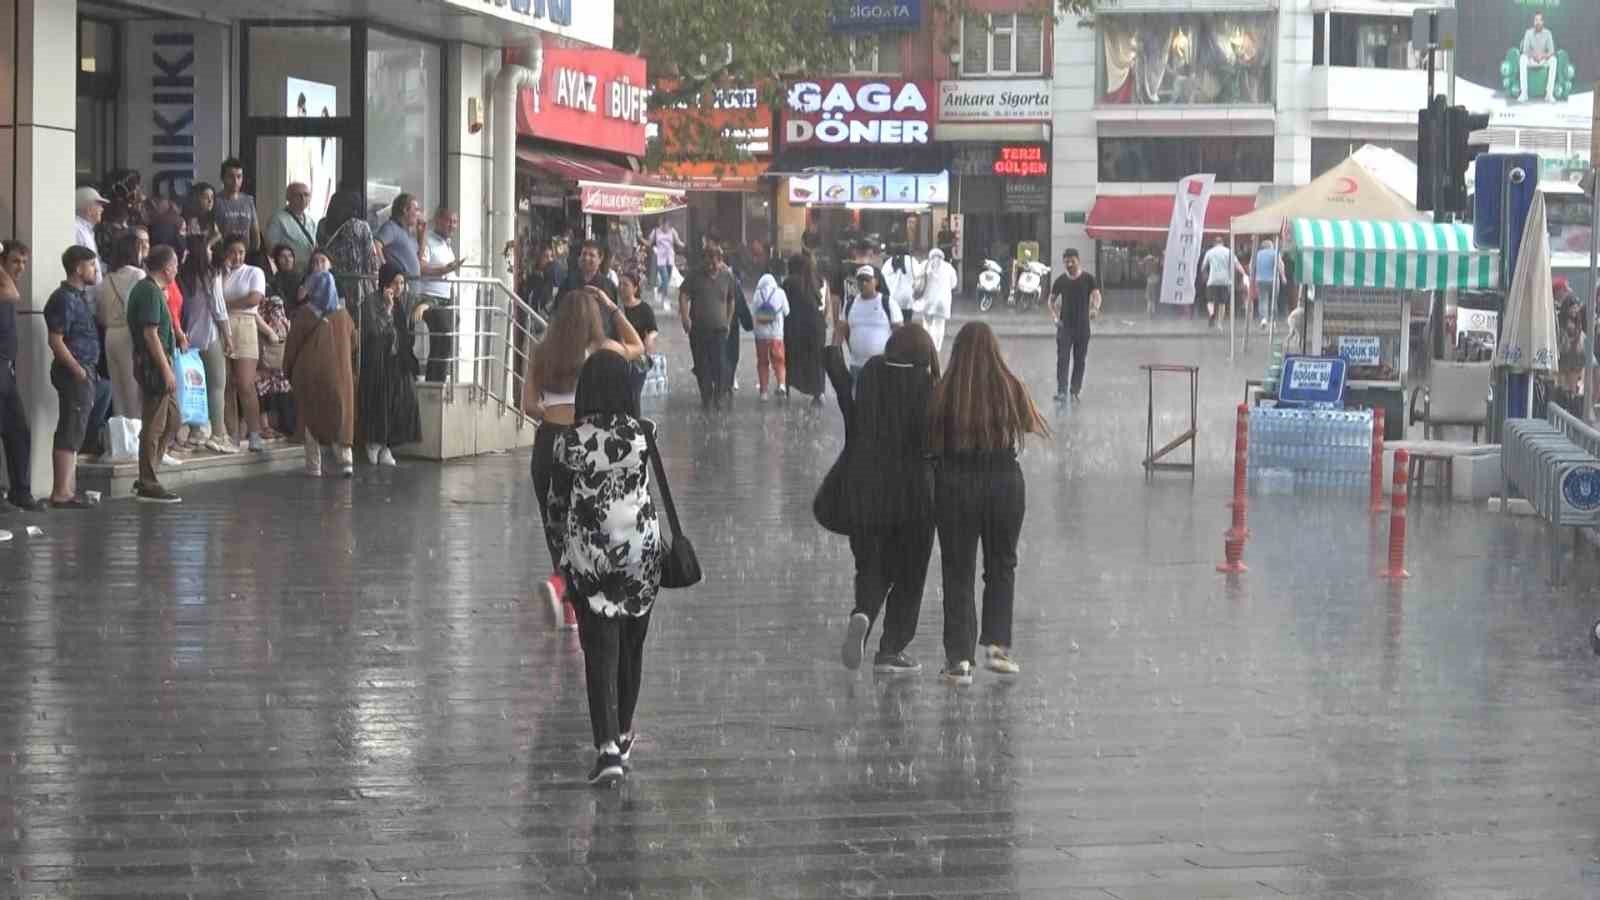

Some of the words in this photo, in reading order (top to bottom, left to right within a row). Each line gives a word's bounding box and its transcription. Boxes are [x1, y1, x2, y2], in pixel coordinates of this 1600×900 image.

[557, 67, 598, 113] AYAZ
[611, 75, 648, 125] BÜFE
[787, 82, 928, 113] GAGA
[944, 92, 995, 107] Ankara
[999, 91, 1050, 108] Sigorta
[786, 112, 929, 144] DÖNER
